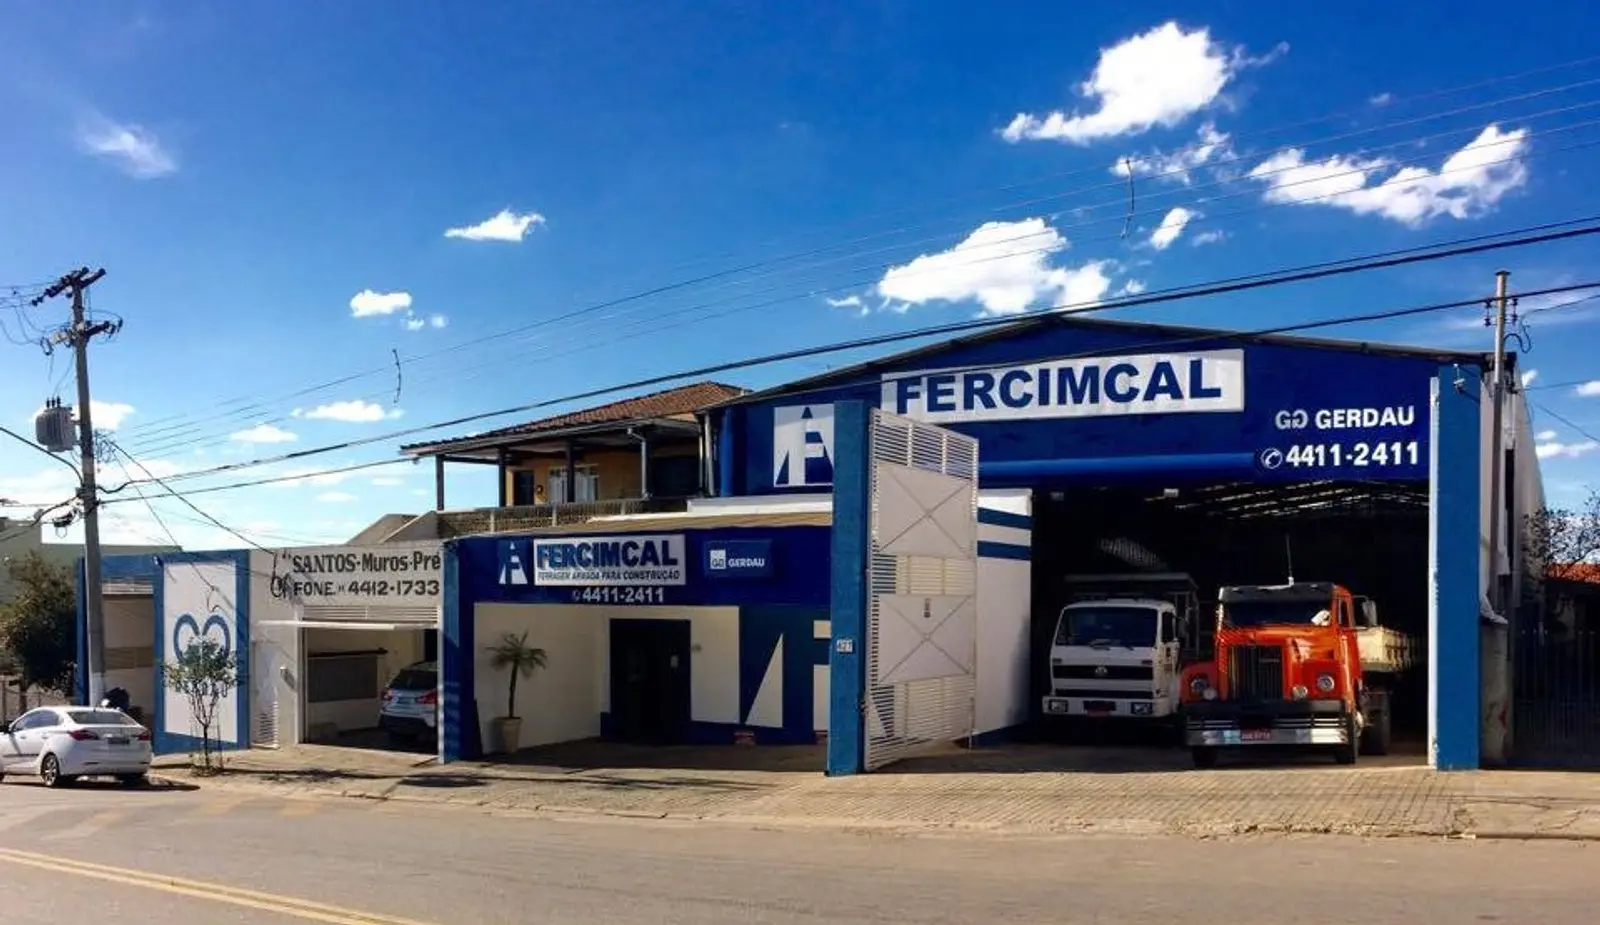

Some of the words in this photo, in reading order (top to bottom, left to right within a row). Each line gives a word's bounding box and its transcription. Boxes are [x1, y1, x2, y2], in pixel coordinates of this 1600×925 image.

[896, 358, 1222, 414] FERCIMCAL
[1315, 405, 1414, 429] GERDAU
[1285, 441, 1418, 467] 4411-2411
[537, 540, 679, 569] FERCIMCAL
[728, 557, 766, 568] GERDAU
[582, 587, 664, 603] 4411-2411
